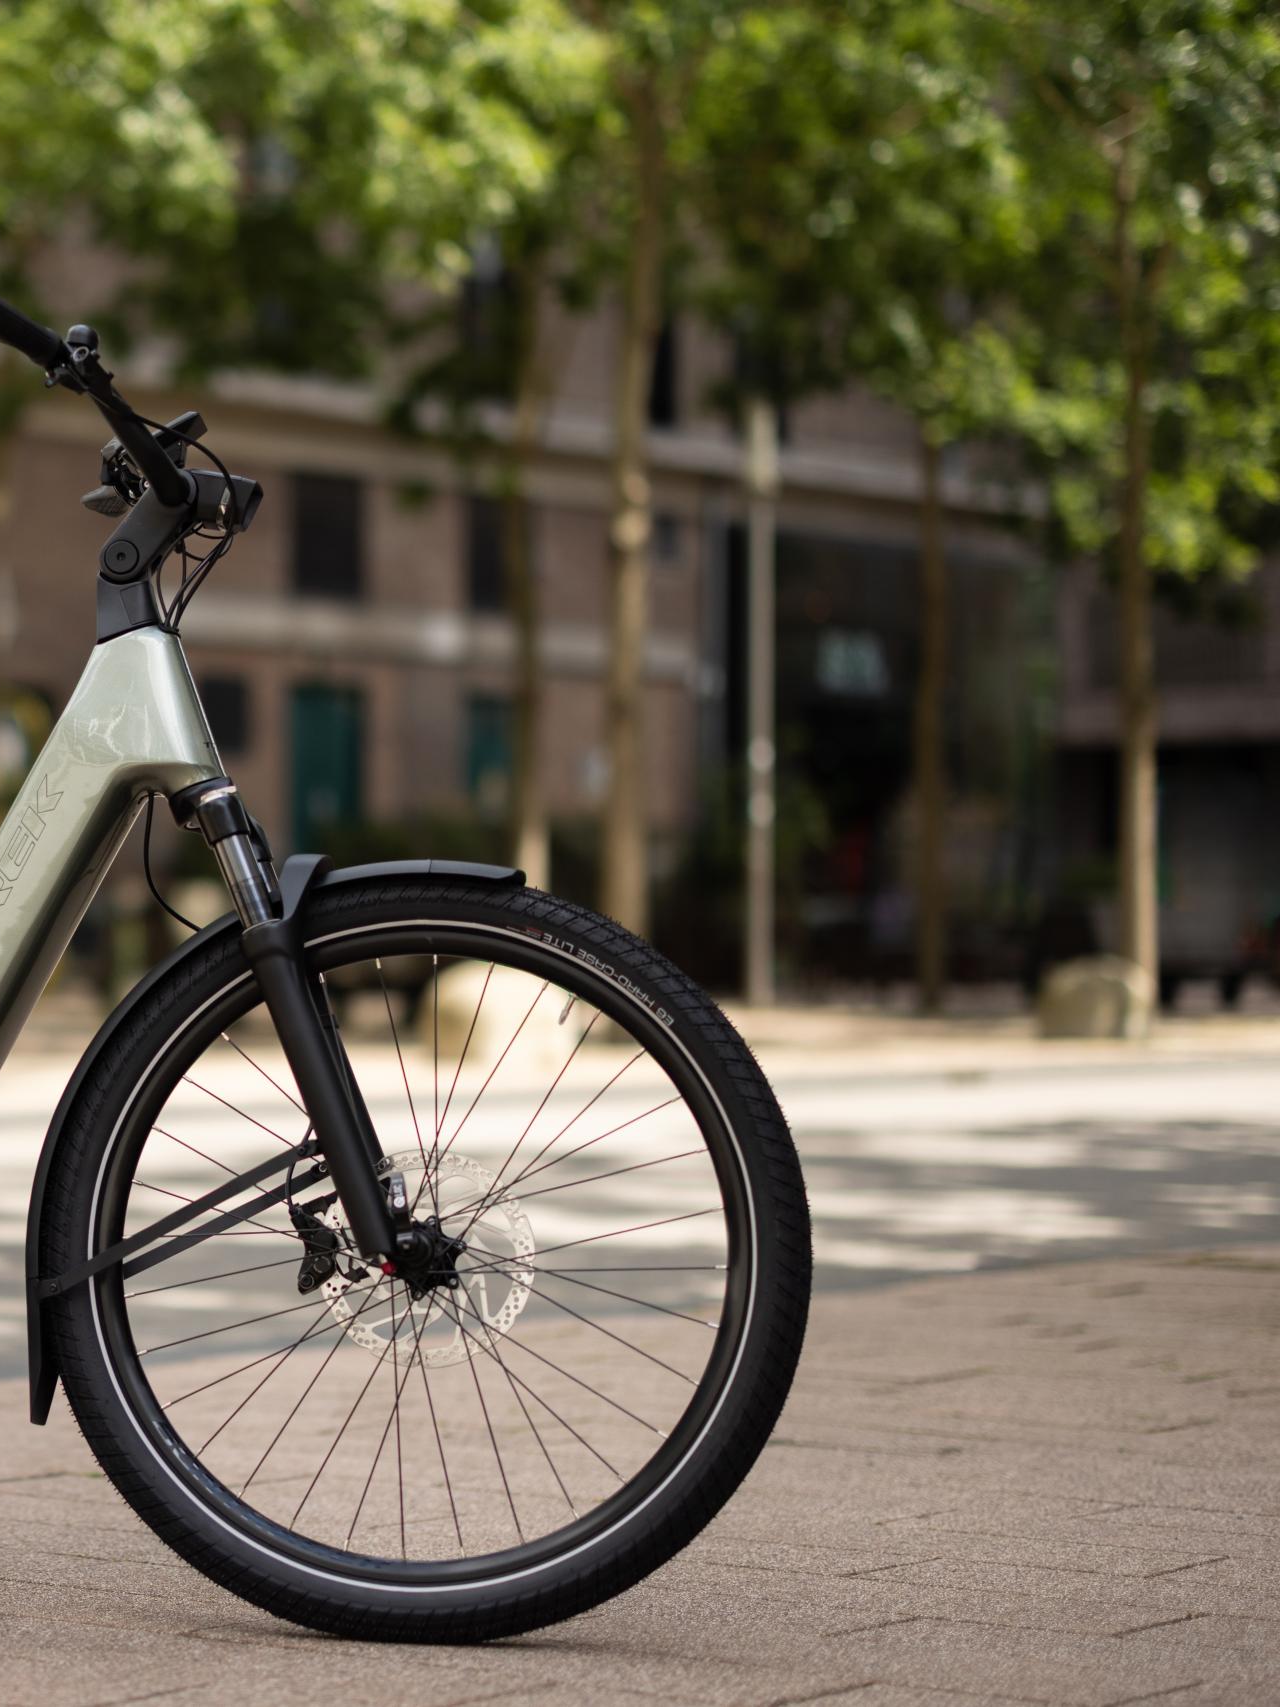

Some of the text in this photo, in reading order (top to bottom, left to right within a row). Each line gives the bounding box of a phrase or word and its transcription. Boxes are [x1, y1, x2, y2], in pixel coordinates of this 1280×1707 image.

[543, 933, 574, 951] LITE
[576, 948, 656, 1008] HARD-CASE
[655, 1007, 675, 1027] E6
